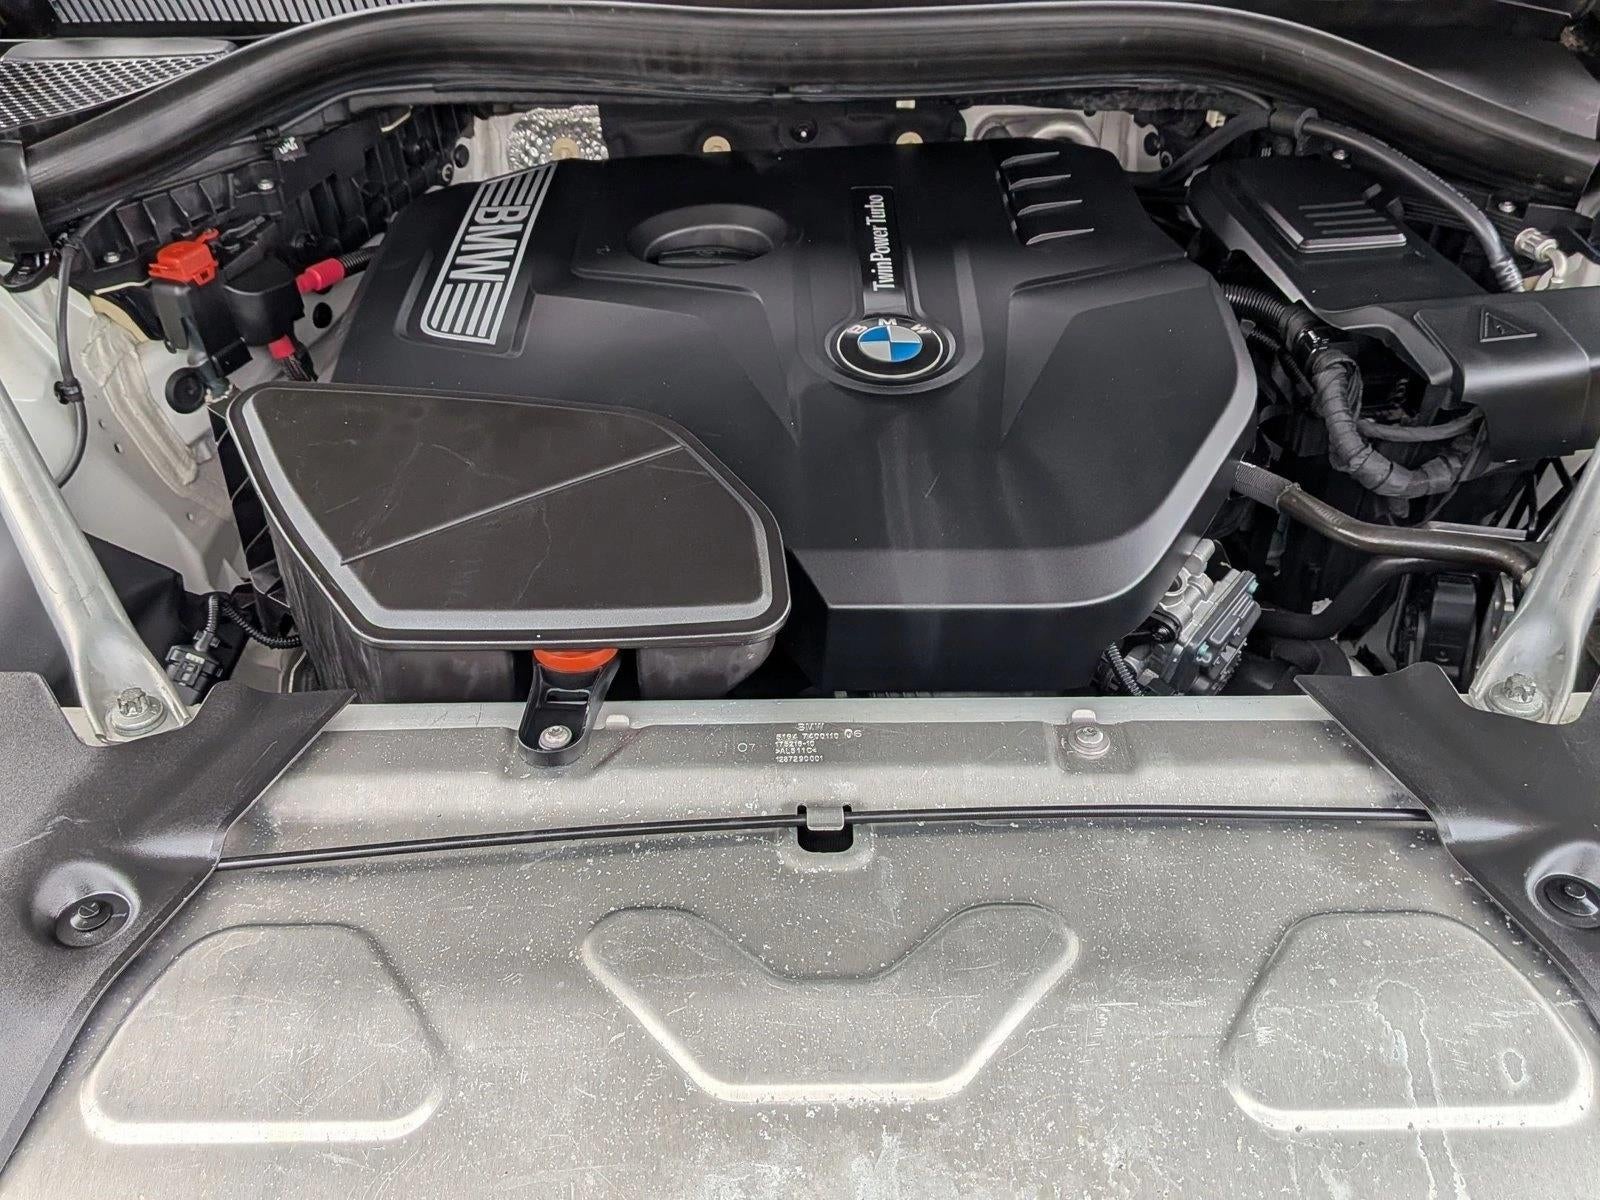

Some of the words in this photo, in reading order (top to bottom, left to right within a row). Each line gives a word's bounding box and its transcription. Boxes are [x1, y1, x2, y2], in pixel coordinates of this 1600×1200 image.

[864, 193, 887, 226] Turbo
[449, 205, 532, 282] BMW
[869, 225, 896, 292] TwinPower
[847, 317, 932, 334] BMW
